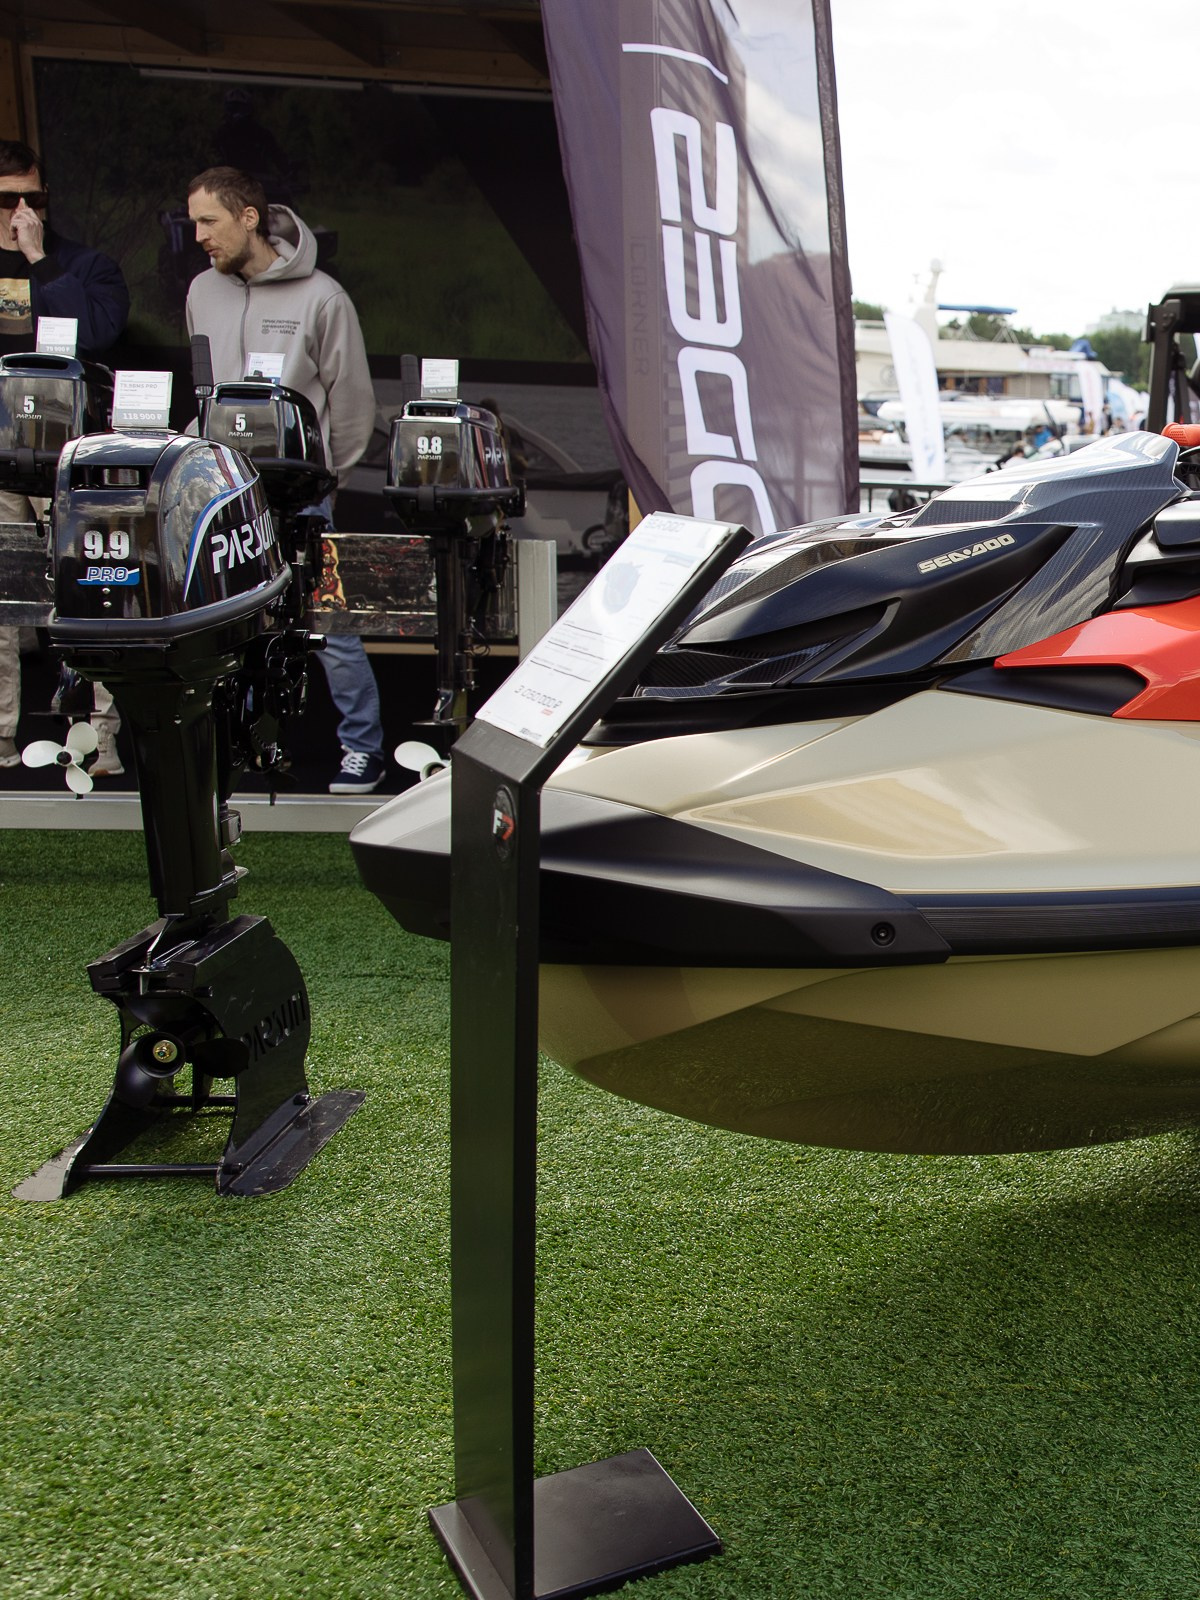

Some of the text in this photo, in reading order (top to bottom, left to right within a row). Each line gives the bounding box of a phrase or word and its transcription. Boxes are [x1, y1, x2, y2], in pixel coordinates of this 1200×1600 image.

[23, 395, 35, 414] 5
[122, 412, 139, 420] 118
[234, 413, 247, 432] 5
[417, 436, 442, 455] 9.8
[83, 530, 131, 560] 9.9
[210, 507, 276, 574] PARSUN
[86, 566, 130, 582] PRO
